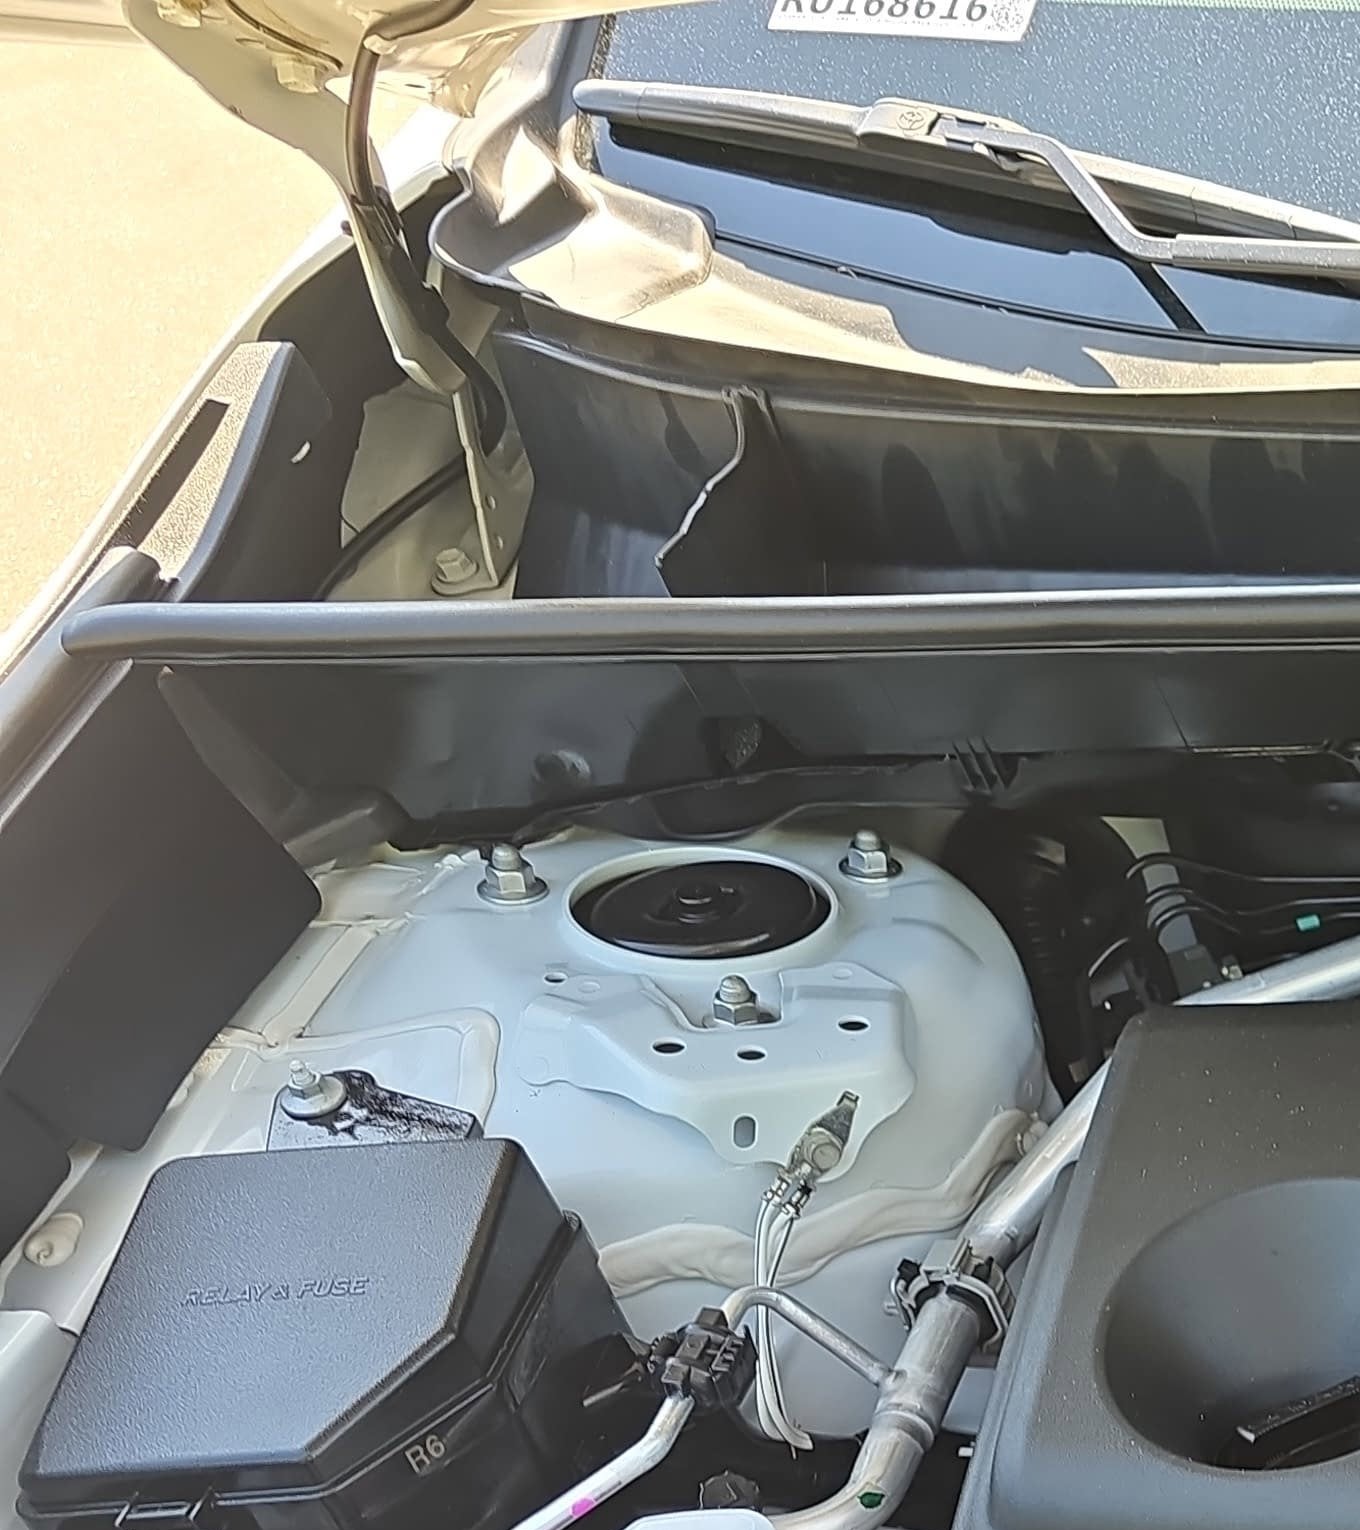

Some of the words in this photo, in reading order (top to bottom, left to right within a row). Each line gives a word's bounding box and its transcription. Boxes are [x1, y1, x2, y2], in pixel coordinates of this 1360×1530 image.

[181, 1284, 271, 1306] RELAY
[297, 1275, 370, 1300] FUSE
[405, 1434, 445, 1473] R6
